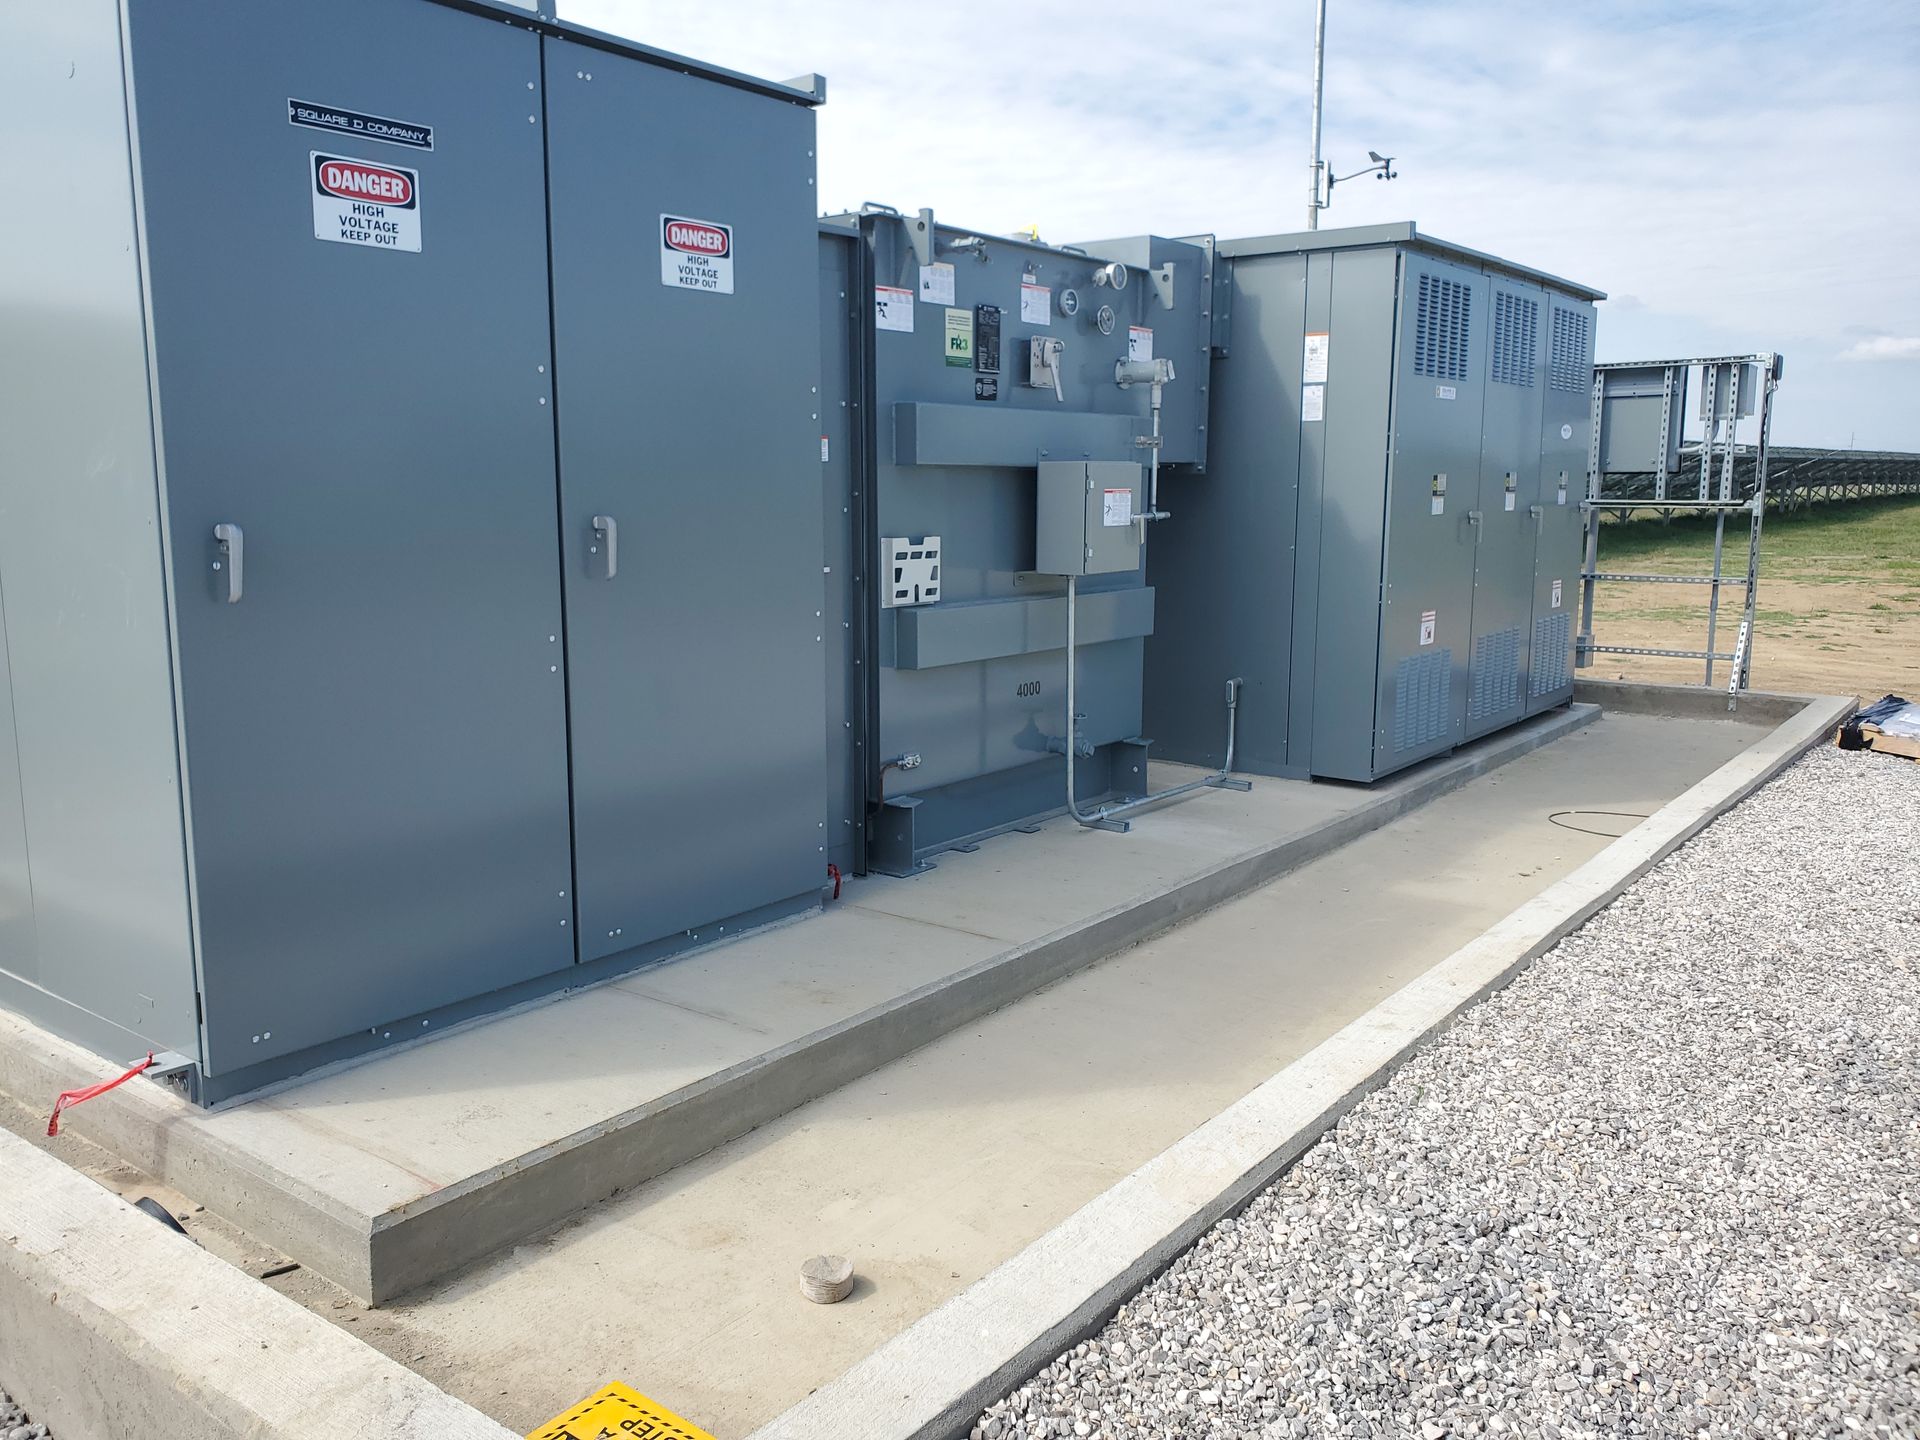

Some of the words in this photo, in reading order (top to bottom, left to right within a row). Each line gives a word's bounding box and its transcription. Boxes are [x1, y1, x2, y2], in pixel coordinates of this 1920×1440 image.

[297, 108, 349, 127] SQUARE
[352, 119, 364, 129] D
[367, 122, 425, 141] COMPANY
[327, 166, 404, 200] DANGER
[352, 203, 385, 218] HIGH
[338, 215, 399, 234] VOLTAGE
[340, 228, 371, 242] KEEP
[375, 232, 398, 245] OUT
[670, 225, 723, 251] DANGER
[687, 255, 709, 266] HIGH
[678, 265, 719, 279] VOLTAGE
[679, 276, 699, 286] KEEP
[702, 280, 718, 288] OUT
[950, 337, 968, 351] FR3
[1016, 680, 1041, 698] 4000
